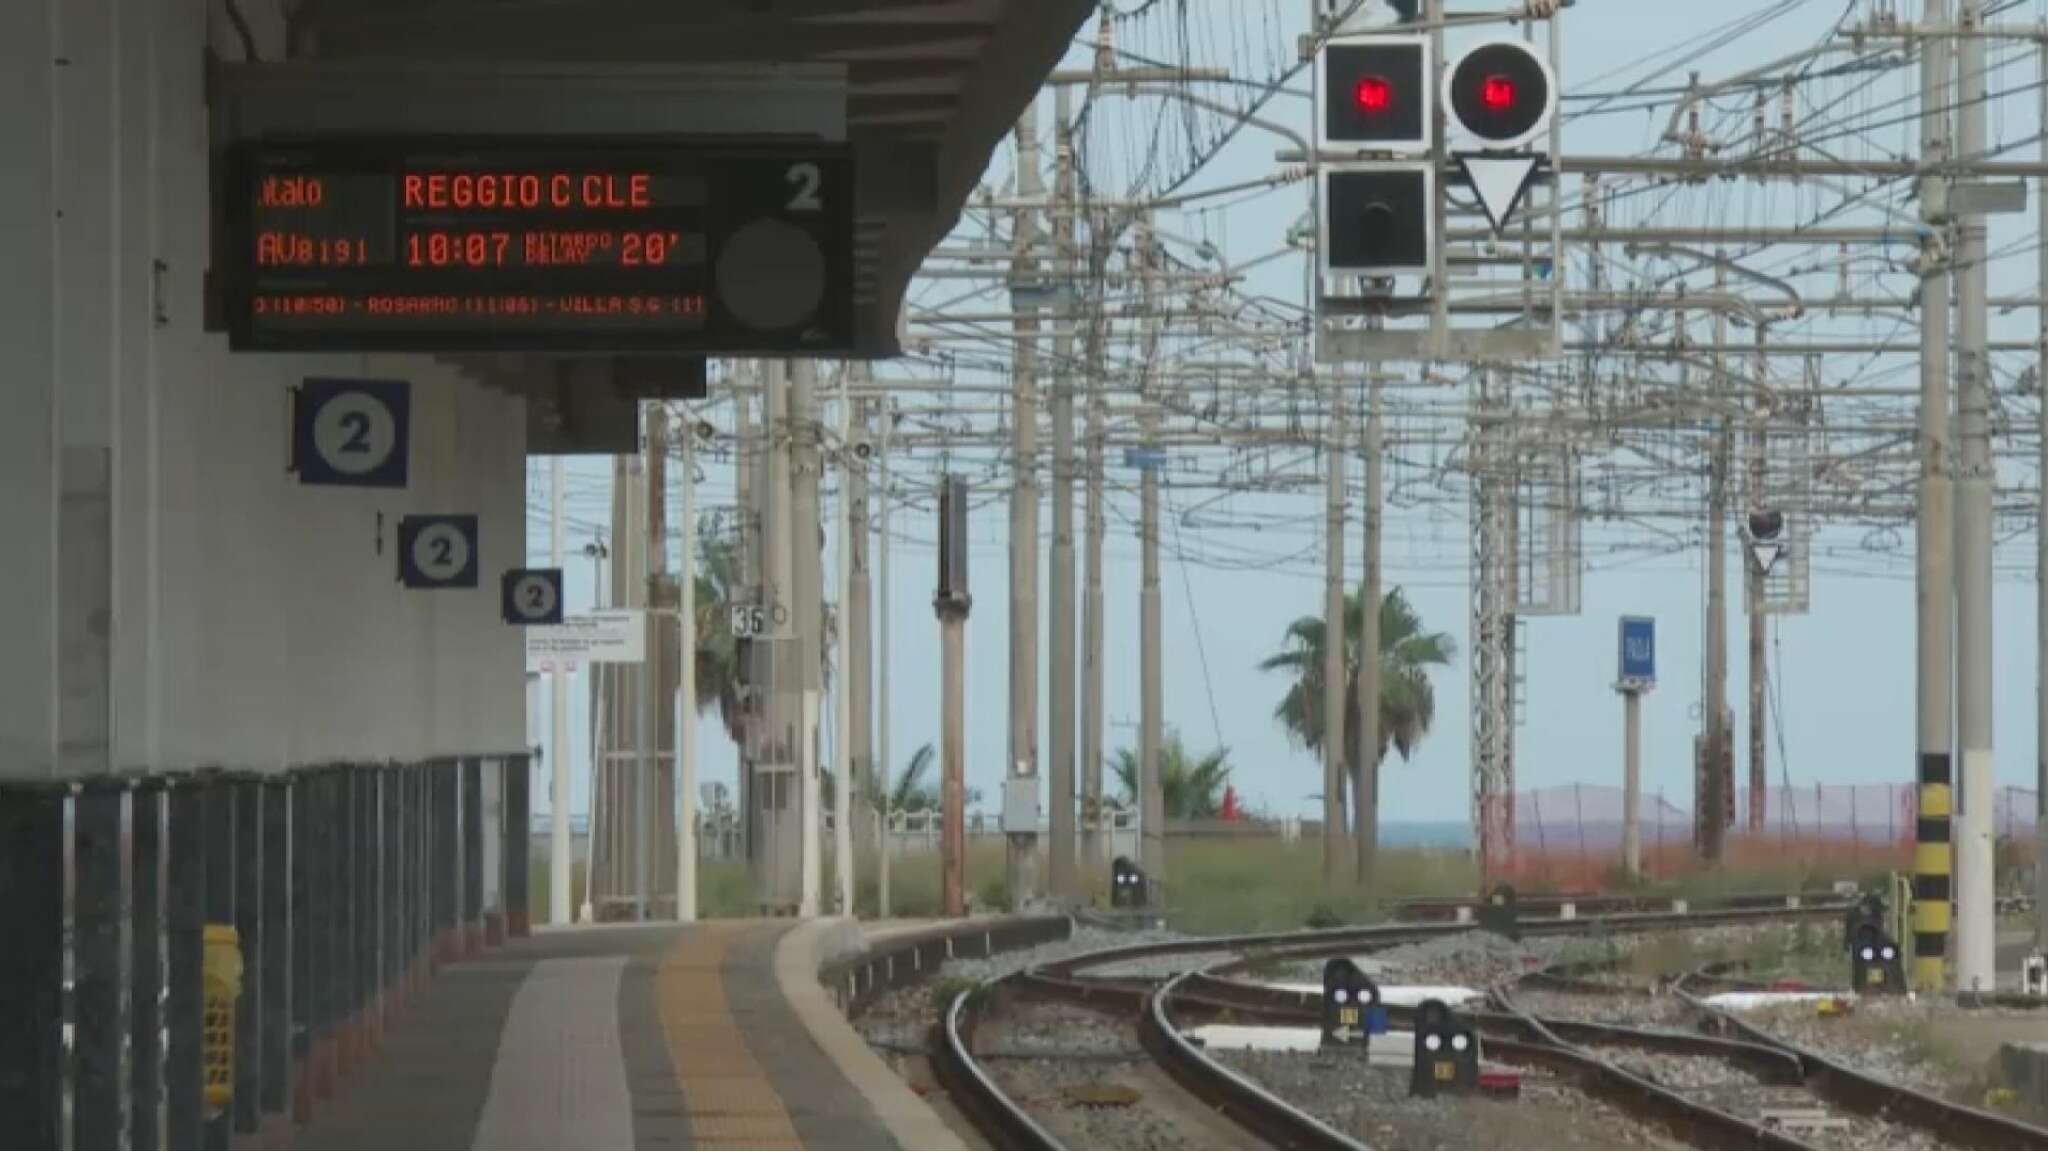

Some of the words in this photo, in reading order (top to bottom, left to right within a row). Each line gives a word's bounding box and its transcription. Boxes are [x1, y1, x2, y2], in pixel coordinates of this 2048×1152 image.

[404, 174, 541, 207] REGGIO
[551, 174, 571, 207] C
[581, 174, 651, 207] CLE
[785, 164, 821, 209] 2
[407, 232, 508, 265] 10:07
[339, 412, 371, 452] 2
[430, 537, 453, 566] 2
[526, 586, 545, 607] 2
